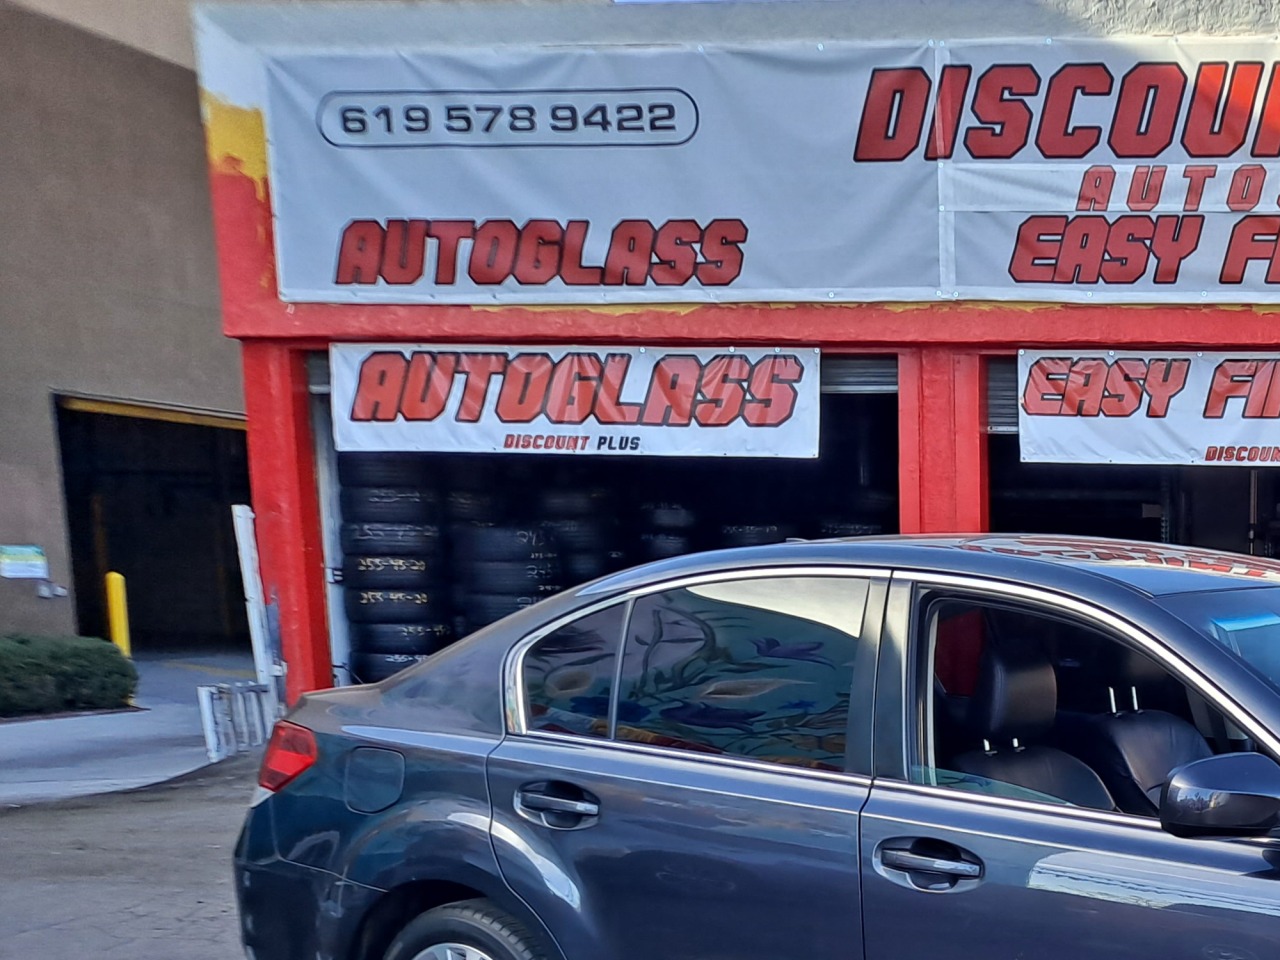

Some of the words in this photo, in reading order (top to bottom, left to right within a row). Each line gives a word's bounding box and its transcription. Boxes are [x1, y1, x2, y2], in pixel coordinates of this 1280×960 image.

[339, 103, 433, 134] 619
[444, 103, 537, 133] 578
[550, 102, 677, 132] 9422
[334, 218, 749, 286] AUTOGLASS
[1008, 213, 1204, 284] EASY
[350, 351, 804, 428] AUTOGLASS
[1021, 357, 1191, 419] EASY
[503, 434, 590, 450] DISCOUNT
[597, 436, 641, 450] PLUS
